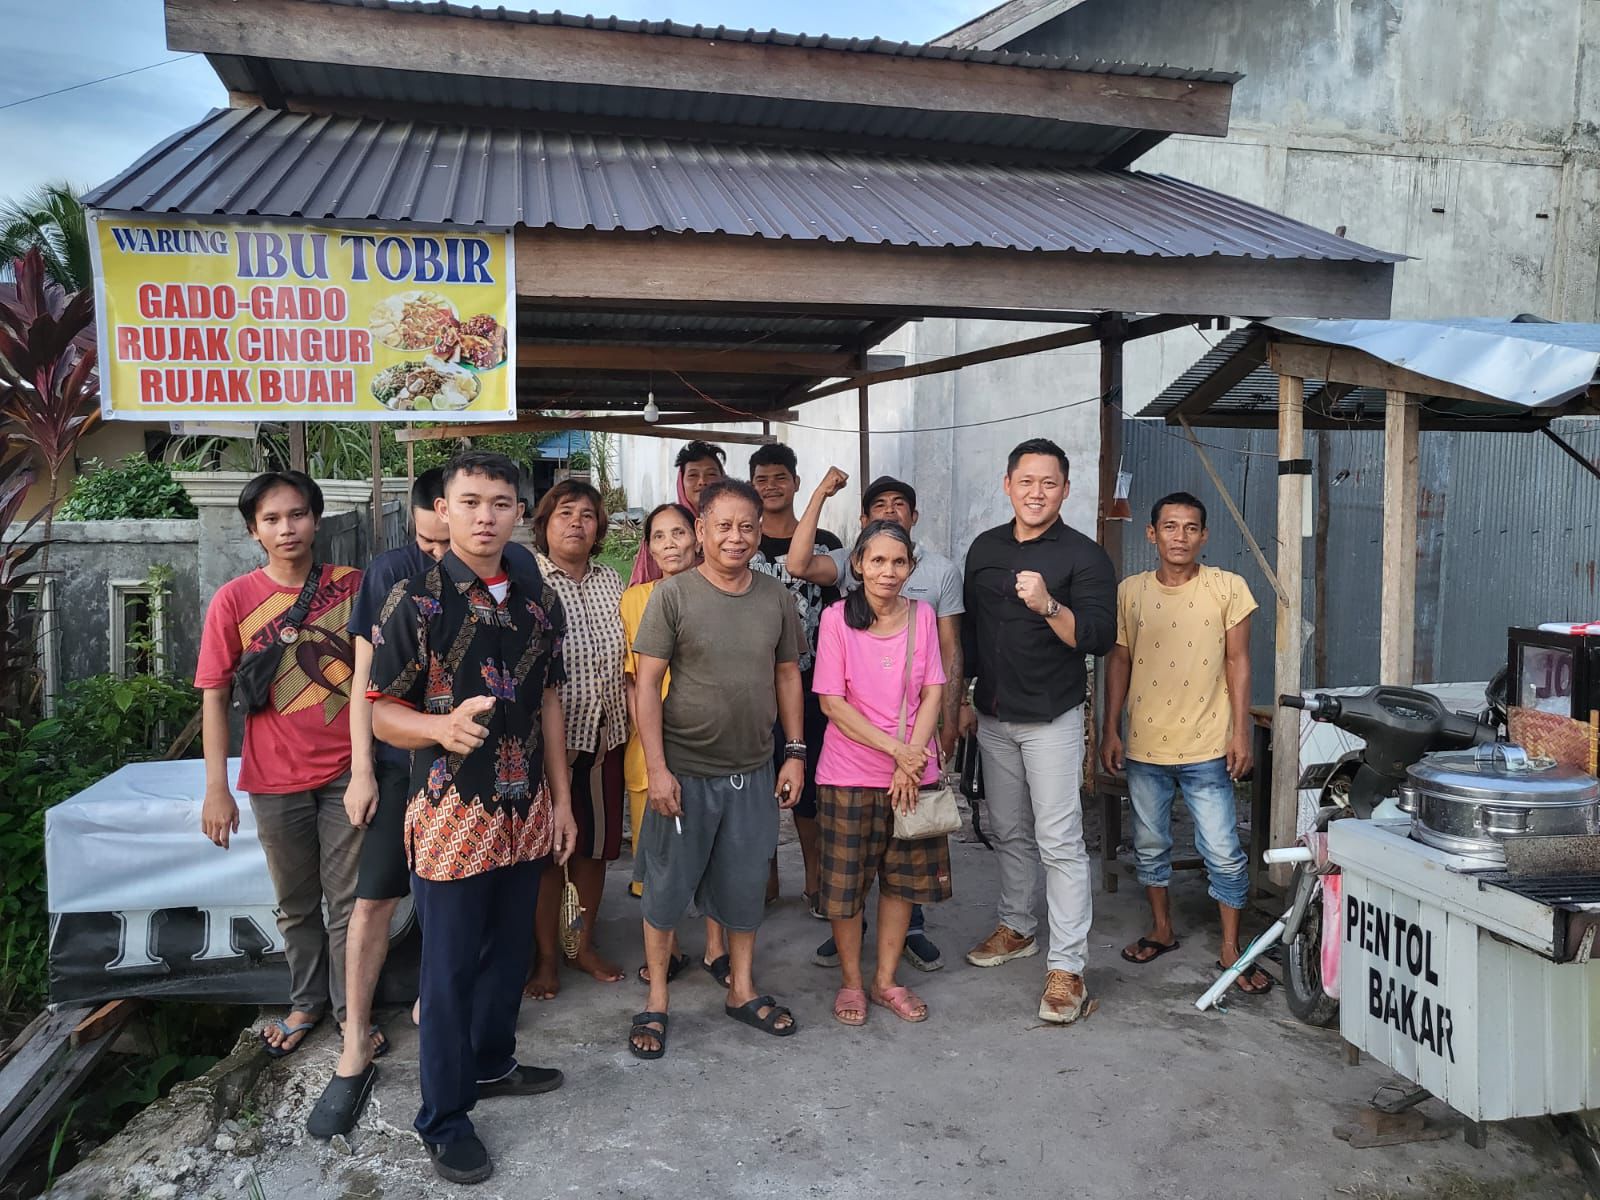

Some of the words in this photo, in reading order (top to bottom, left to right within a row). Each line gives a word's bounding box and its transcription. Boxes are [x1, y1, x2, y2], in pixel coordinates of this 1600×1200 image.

[112, 228, 229, 255] WARUNG
[235, 231, 329, 280] IBU
[341, 235, 495, 284] TOBIR
[138, 283, 347, 321] GADO-GADO
[117, 326, 231, 362] RUJAK
[237, 327, 371, 364] CINGUR
[139, 368, 251, 404] RUJAK
[258, 369, 355, 404] BUAH
[1346, 894, 1439, 987] PENTOL
[1368, 967, 1455, 1064] BAKAR
